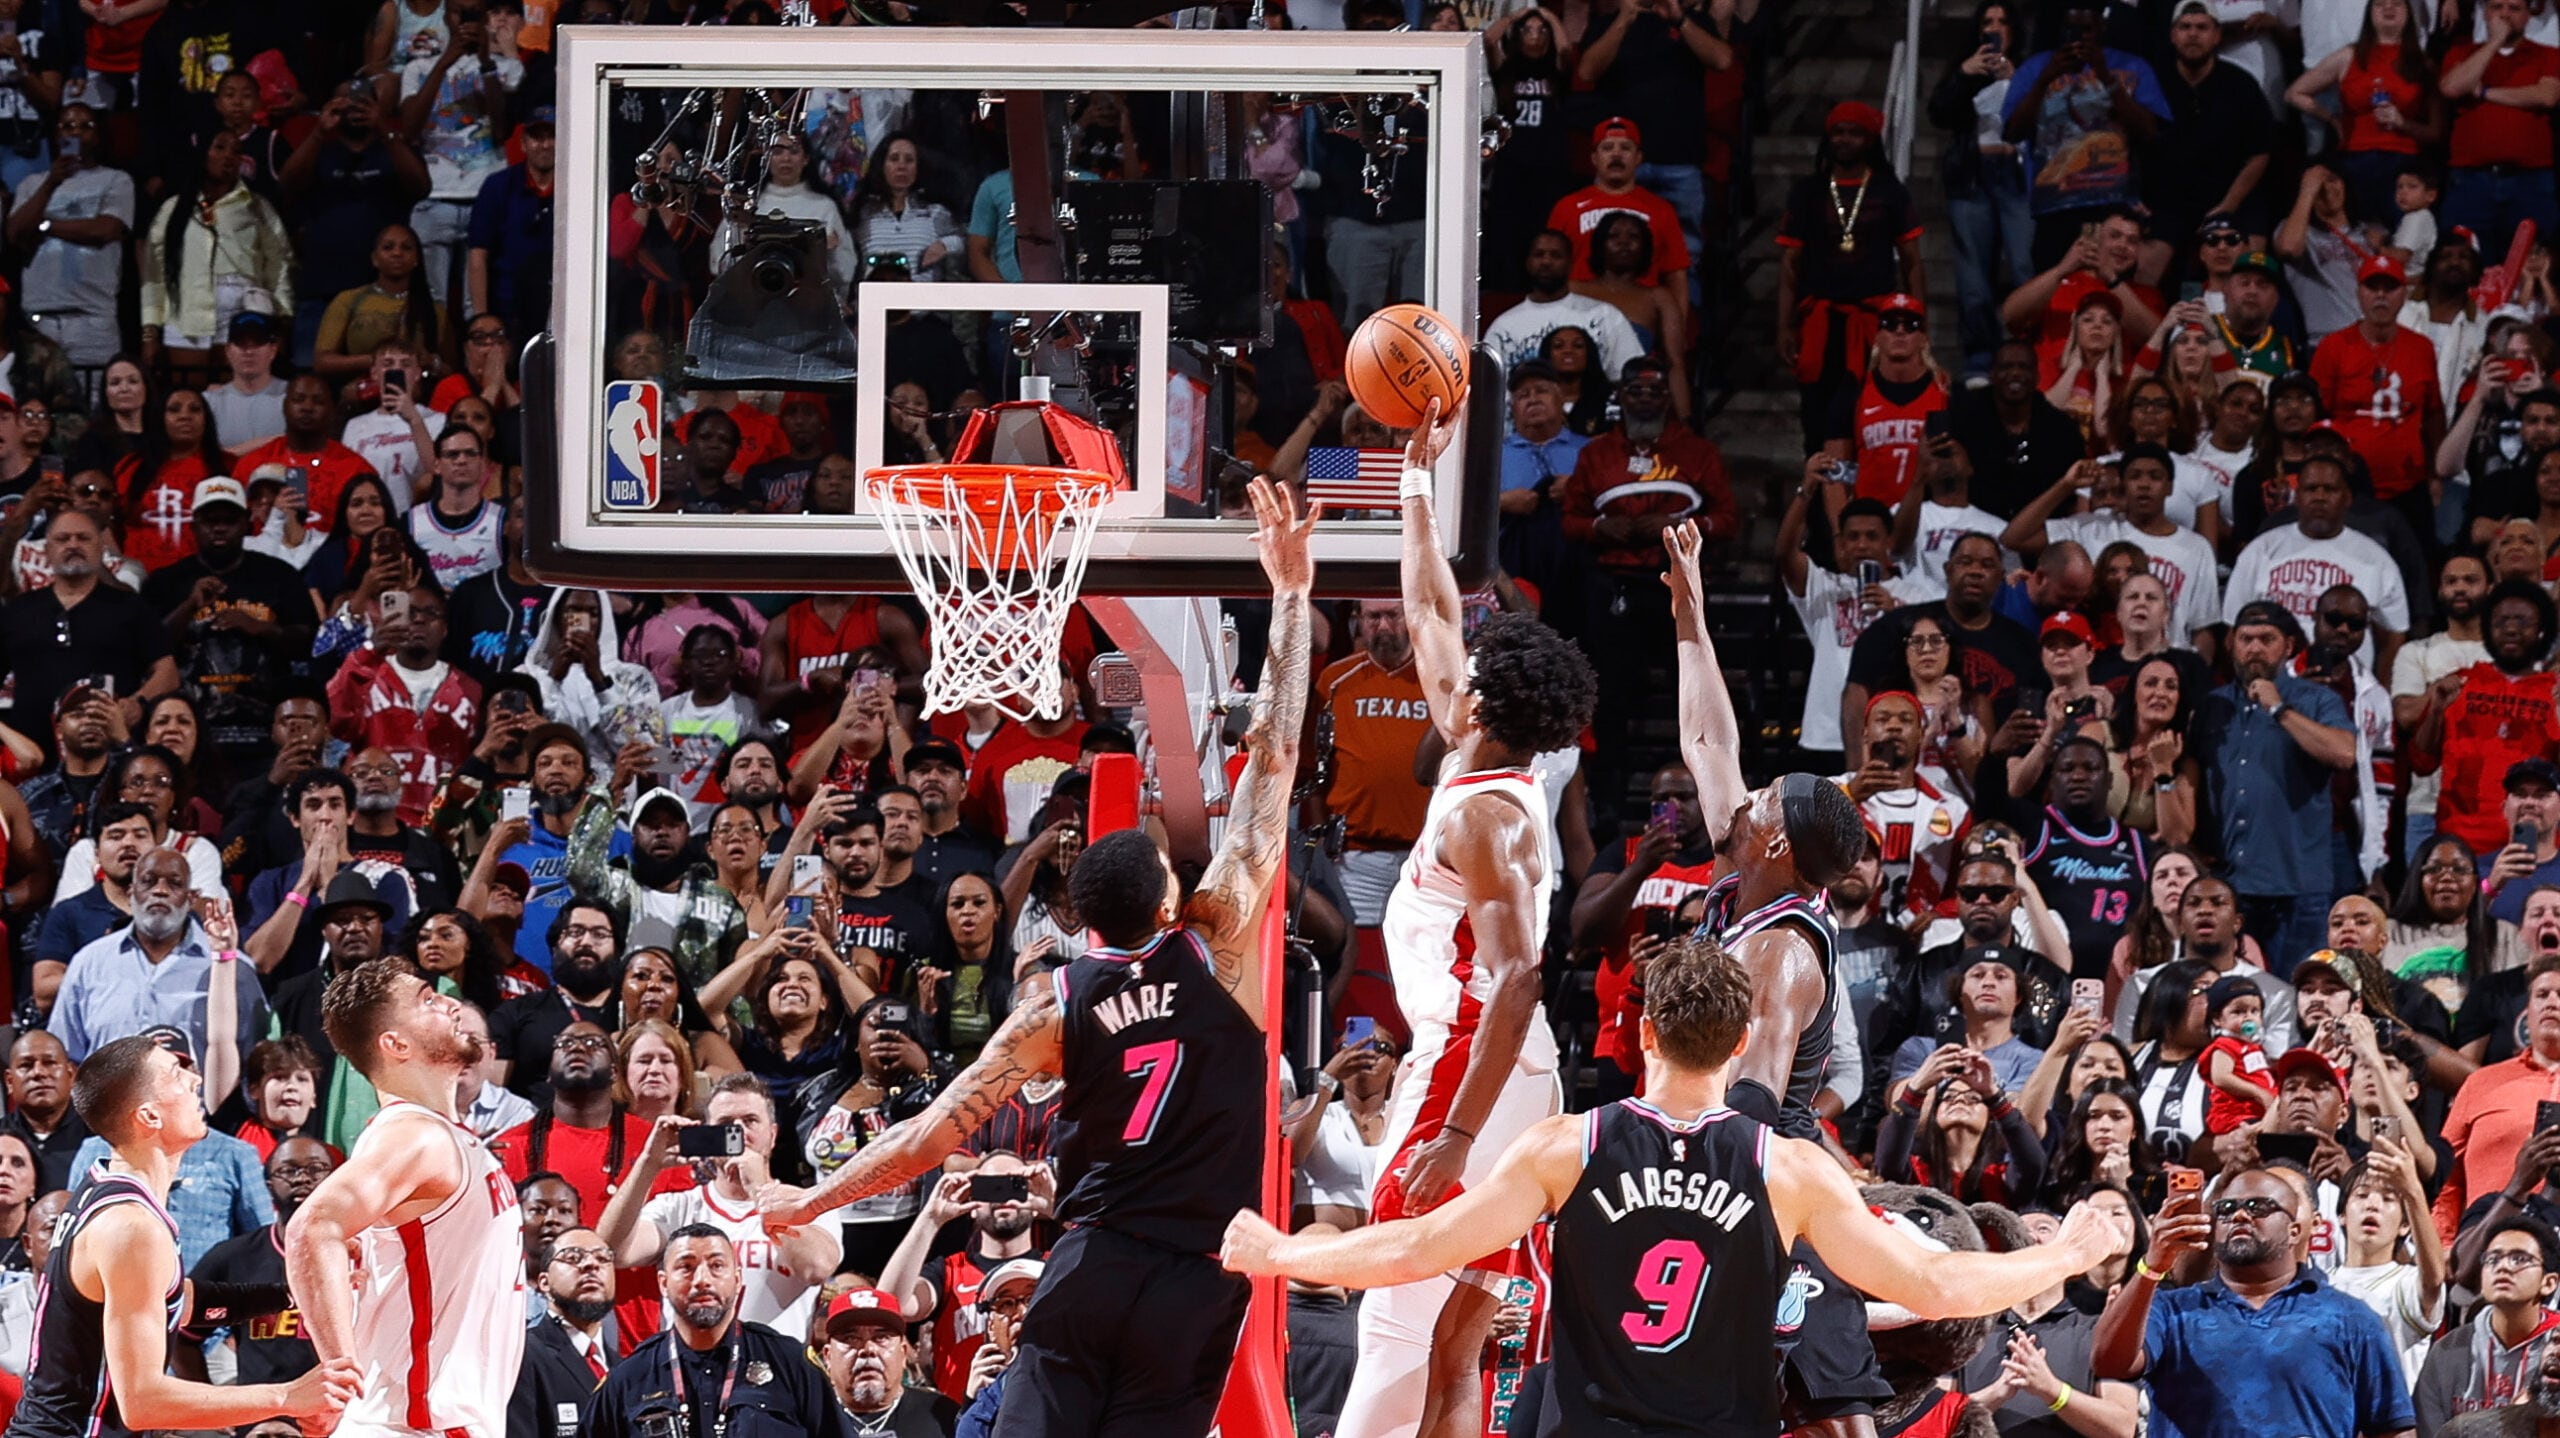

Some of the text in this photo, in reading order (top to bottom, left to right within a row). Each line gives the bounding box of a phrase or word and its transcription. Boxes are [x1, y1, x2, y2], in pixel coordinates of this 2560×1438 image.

[1515, 99, 1543, 126] 28
[1413, 314, 1464, 388] Wilson
[1891, 448, 1910, 484] 7
[611, 480, 639, 501] NBA
[1354, 696, 1428, 721] TEXAS
[2048, 856, 2131, 884] Miami
[2090, 887, 2130, 926] 13
[840, 922, 908, 952] LTURE
[1093, 981, 1180, 1036] WARE
[1121, 1038, 1184, 1147] 7
[1591, 1167, 1755, 1233] LARSSON
[1620, 1238, 1712, 1354] 9
